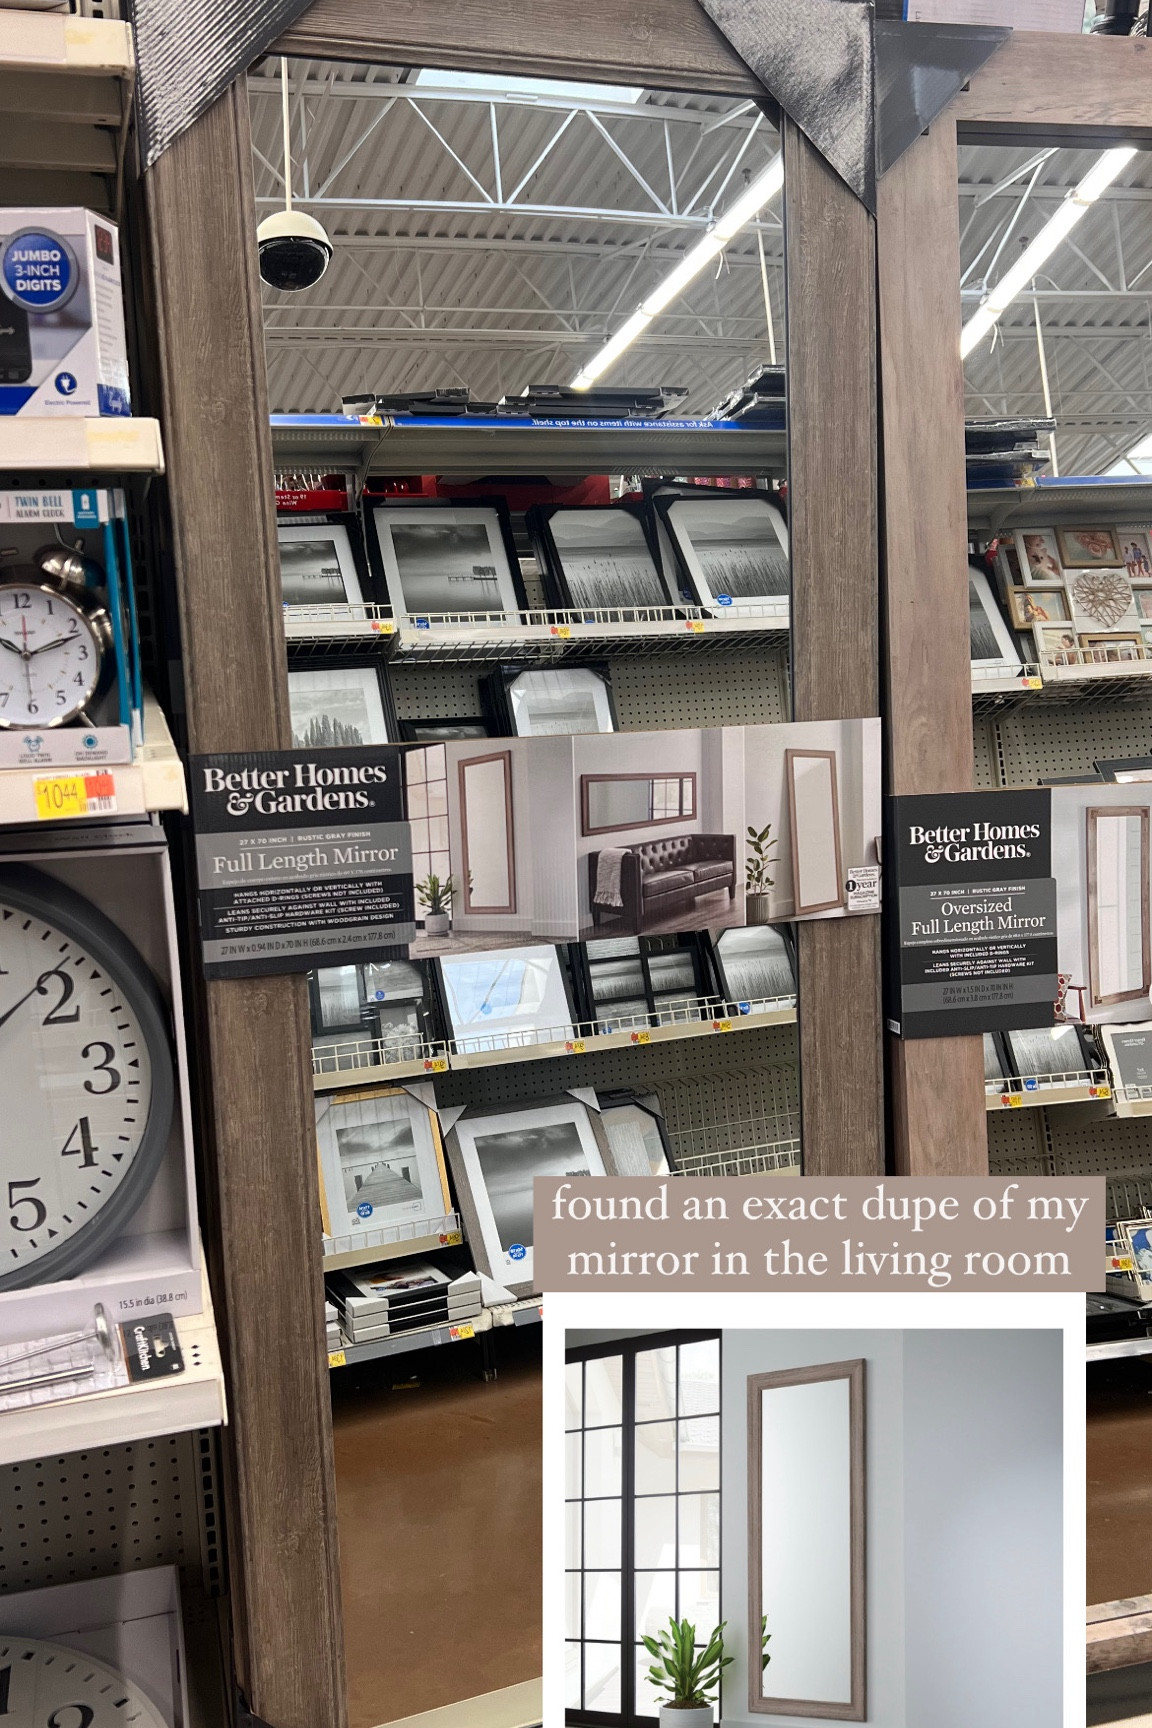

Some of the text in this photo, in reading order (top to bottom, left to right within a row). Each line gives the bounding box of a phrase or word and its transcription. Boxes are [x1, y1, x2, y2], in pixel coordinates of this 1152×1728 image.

[12, 250, 61, 262] JUMBO
[15, 265, 60, 276] 3-INCH
[16, 280, 62, 291] DIGITS
[15, 496, 63, 507] TWIN BELL
[14, 593, 32, 609] 12
[47, 600, 54, 615] 1
[68, 619, 79, 633] 2
[78, 646, 88, 660] 3
[74, 672, 85, 686] 4
[56, 690, 67, 705] 5
[28, 700, 39, 714] 6
[204, 764, 387, 793] Better Homes
[909, 822, 1041, 845] Better Homes
[213, 846, 399, 874] Full Length Mirror
[260, 887, 312, 896] HORIZONTALLY
[325, 882, 364, 891] VERTICALLY
[856, 881, 877, 891] year
[233, 897, 270, 905] ATTACHED
[301, 892, 332, 900] (SCREWS
[251, 906, 286, 914] SECURELY
[288, 903, 317, 911] AGAINST
[358, 896, 391, 904] INCLUDED
[285, 909, 324, 918] HARDWARE
[337, 905, 363, 914] (SCREW
[364, 903, 400, 911] INCLUDED)
[942, 897, 1013, 916] Oversized
[225, 926, 253, 934] STURDY
[254, 921, 307, 931] CONSTRUCTION
[912, 914, 1046, 935] Full Length Mirror
[221, 946, 228, 955] 27
[229, 946, 237, 954] IN
[237, 945, 245, 954] W
[251, 942, 266, 952] 0.94
[267, 942, 274, 950] IN
[275, 941, 281, 950] D
[286, 939, 294, 948] 70
[295, 939, 301, 947] IN
[303, 938, 308, 947] H
[310, 936, 325, 947] (68.6
[326, 937, 337, 945] cm
[342, 934, 352, 944] 2.4
[368, 932, 383, 941] 177.8
[384, 931, 395, 940] cm)
[951, 946, 988, 954] HORIZONTALLY
[37, 970, 81, 1027] 2
[81, 1041, 122, 1095] 3
[61, 1116, 100, 1170] 4
[8, 1178, 47, 1232] 5
[120, 1291, 187, 1309] 15.5 in dia (38.8 cm)
